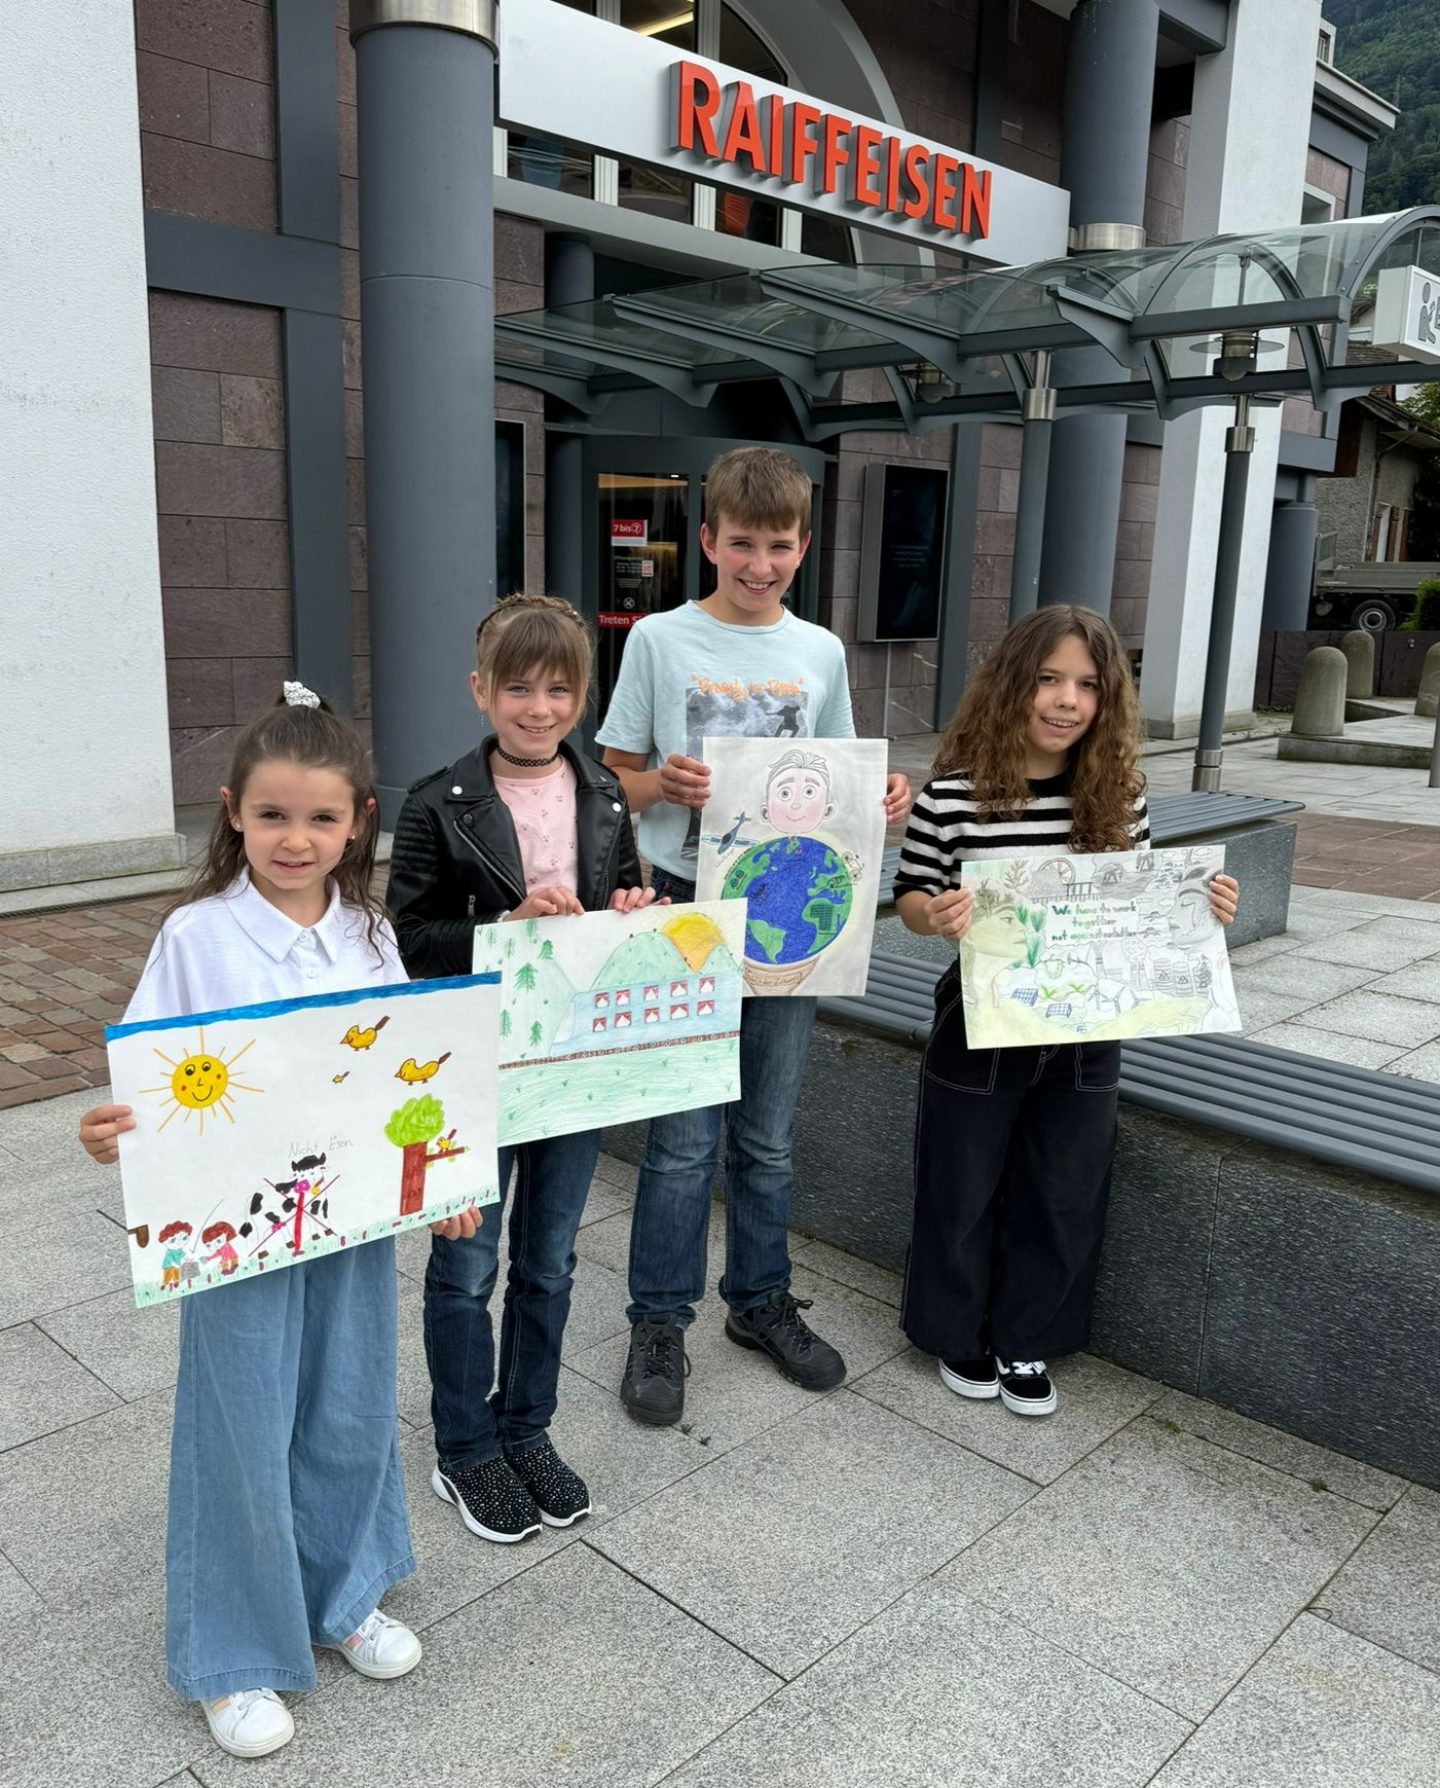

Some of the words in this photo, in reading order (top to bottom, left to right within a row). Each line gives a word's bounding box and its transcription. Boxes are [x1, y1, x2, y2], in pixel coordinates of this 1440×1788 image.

[672, 60, 992, 239] RAIFFEISEN
[620, 523, 631, 533] bis
[598, 614, 631, 625] Treten
[1052, 905, 1071, 915] We
[1112, 901, 1136, 912] work
[1072, 915, 1117, 929] together
[1052, 929, 1067, 940] not
[289, 1139, 319, 1157] Nicht
